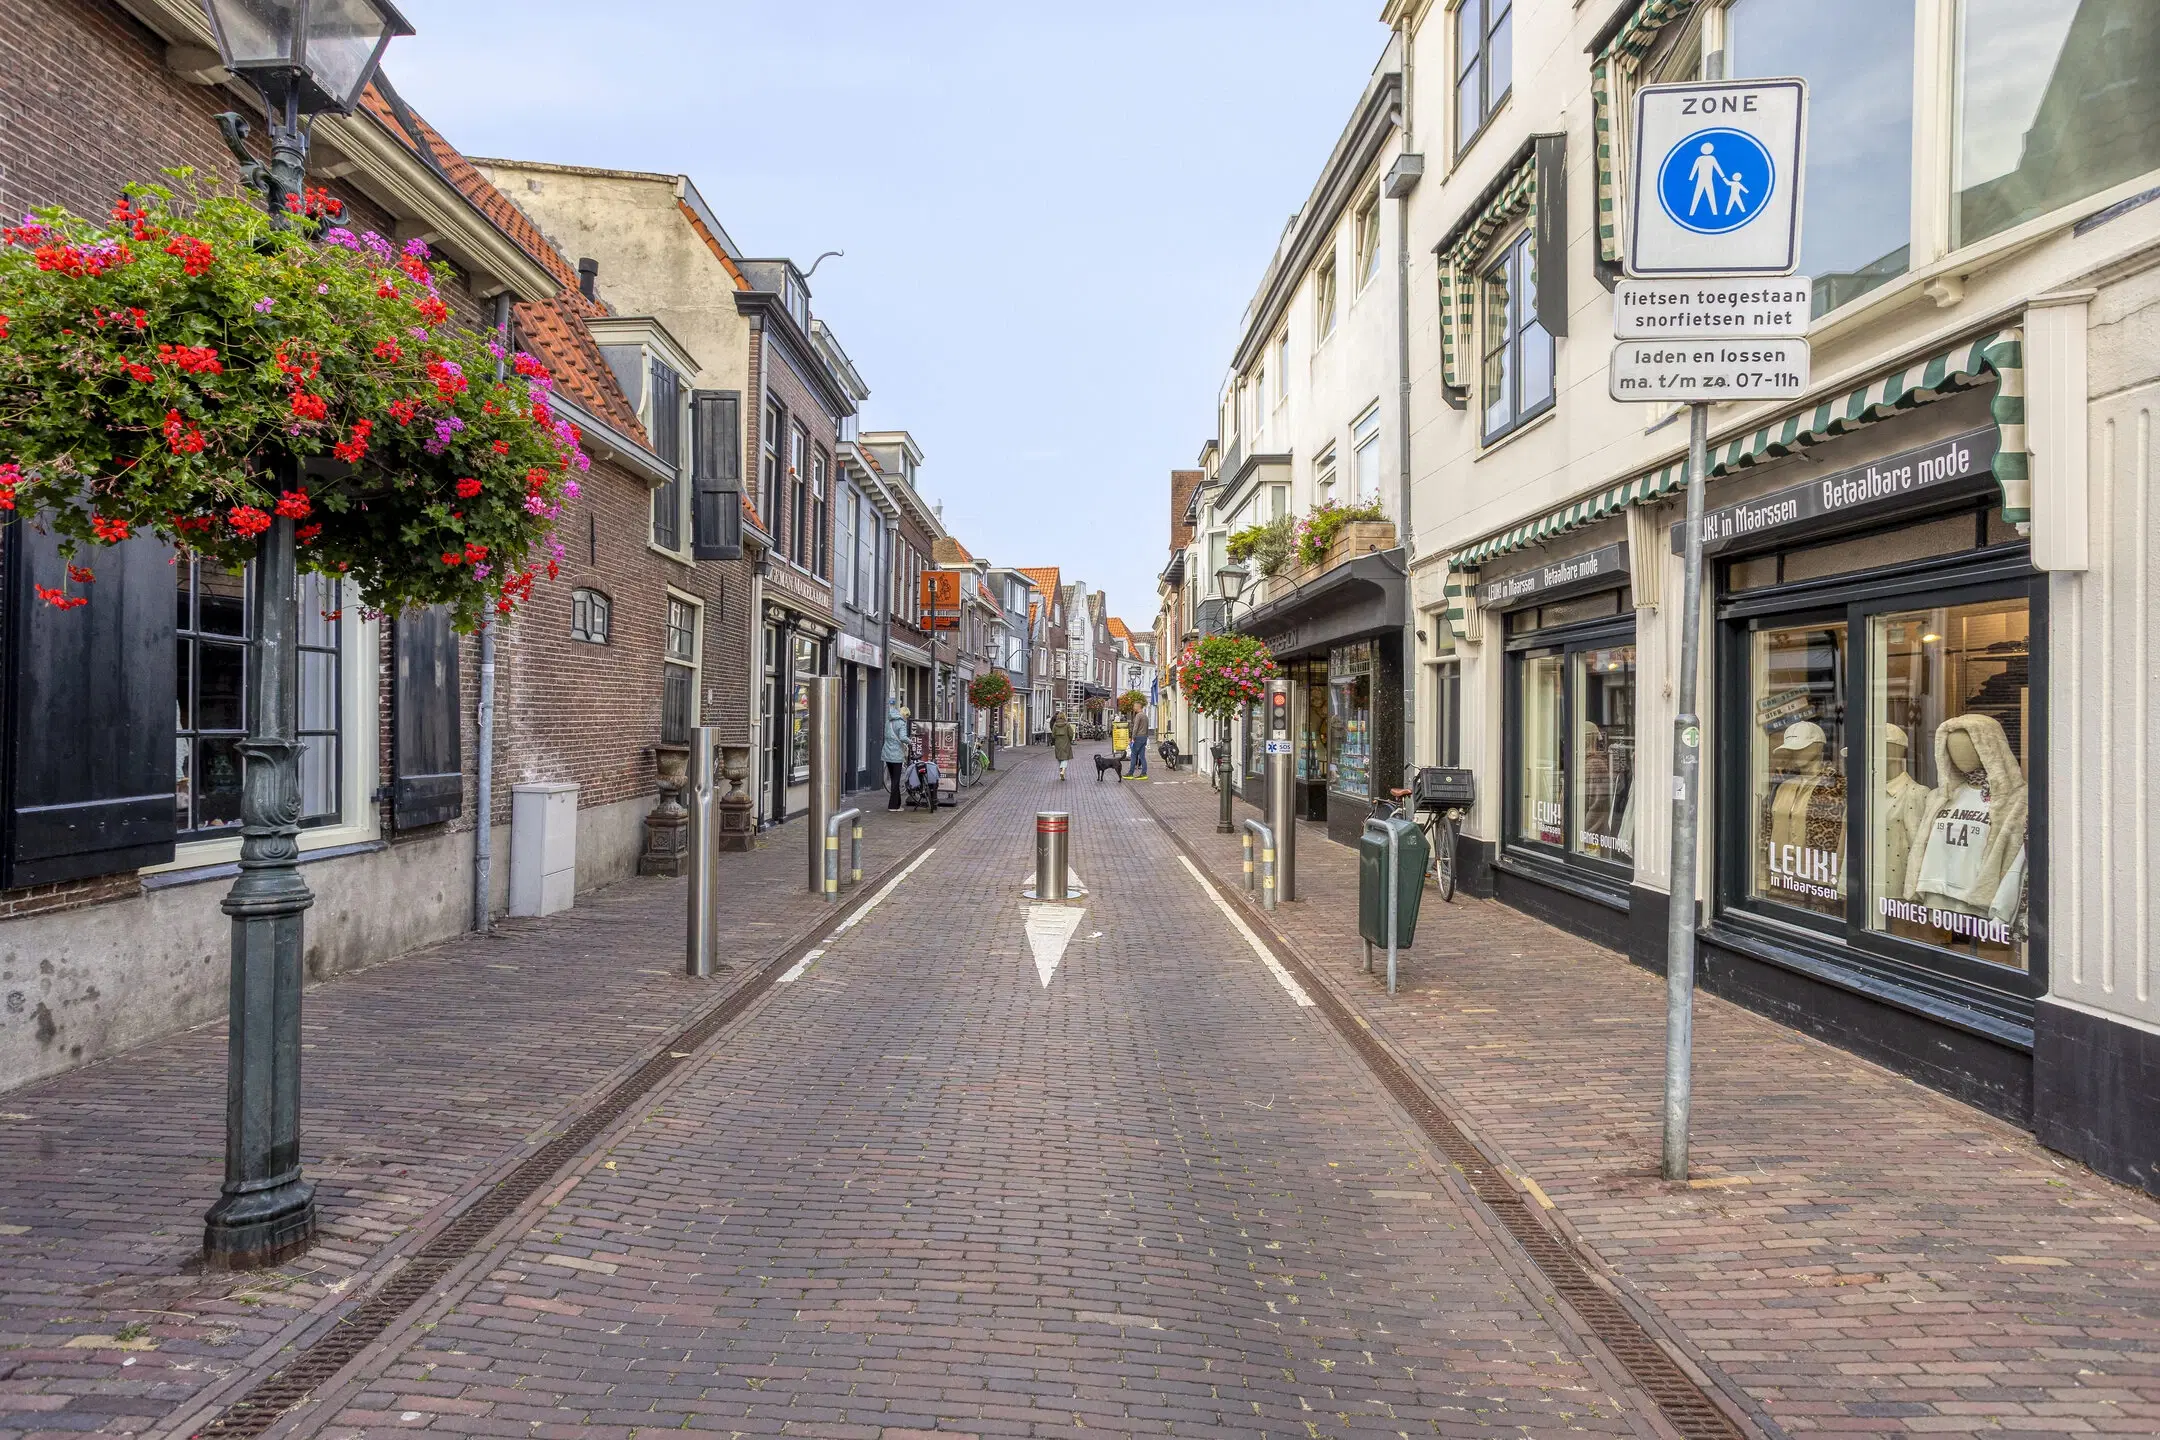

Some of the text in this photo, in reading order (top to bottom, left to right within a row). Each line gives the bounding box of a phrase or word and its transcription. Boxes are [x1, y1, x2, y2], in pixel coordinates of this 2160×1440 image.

[1681, 94, 1758, 115] ZONE
[1623, 288, 1806, 308] fietsen toegestaan
[1635, 310, 1792, 327] snorfietsen niet
[1635, 348, 1786, 364] laden en lossen
[1620, 377, 1653, 389] ma.
[1659, 373, 1696, 388] t/m
[1736, 372, 1799, 388] 07-11h
[1721, 512, 1733, 537] in
[1735, 498, 1798, 532] Maarssen
[1822, 465, 1911, 511] Betaalbare
[1917, 442, 1970, 485] mode
[1488, 554, 1598, 602] LEUK! in Maarssen Betaalbare mode
[1532, 799, 1561, 825] LEUK!
[1600, 834, 1629, 853] BOUTIQUE
[1937, 821, 1980, 847] 19 LA 79
[1769, 841, 1838, 885] LEUK!
[1770, 871, 1838, 900] in Maarssen
[1879, 896, 2010, 945] DAMES BOUTIQUE
